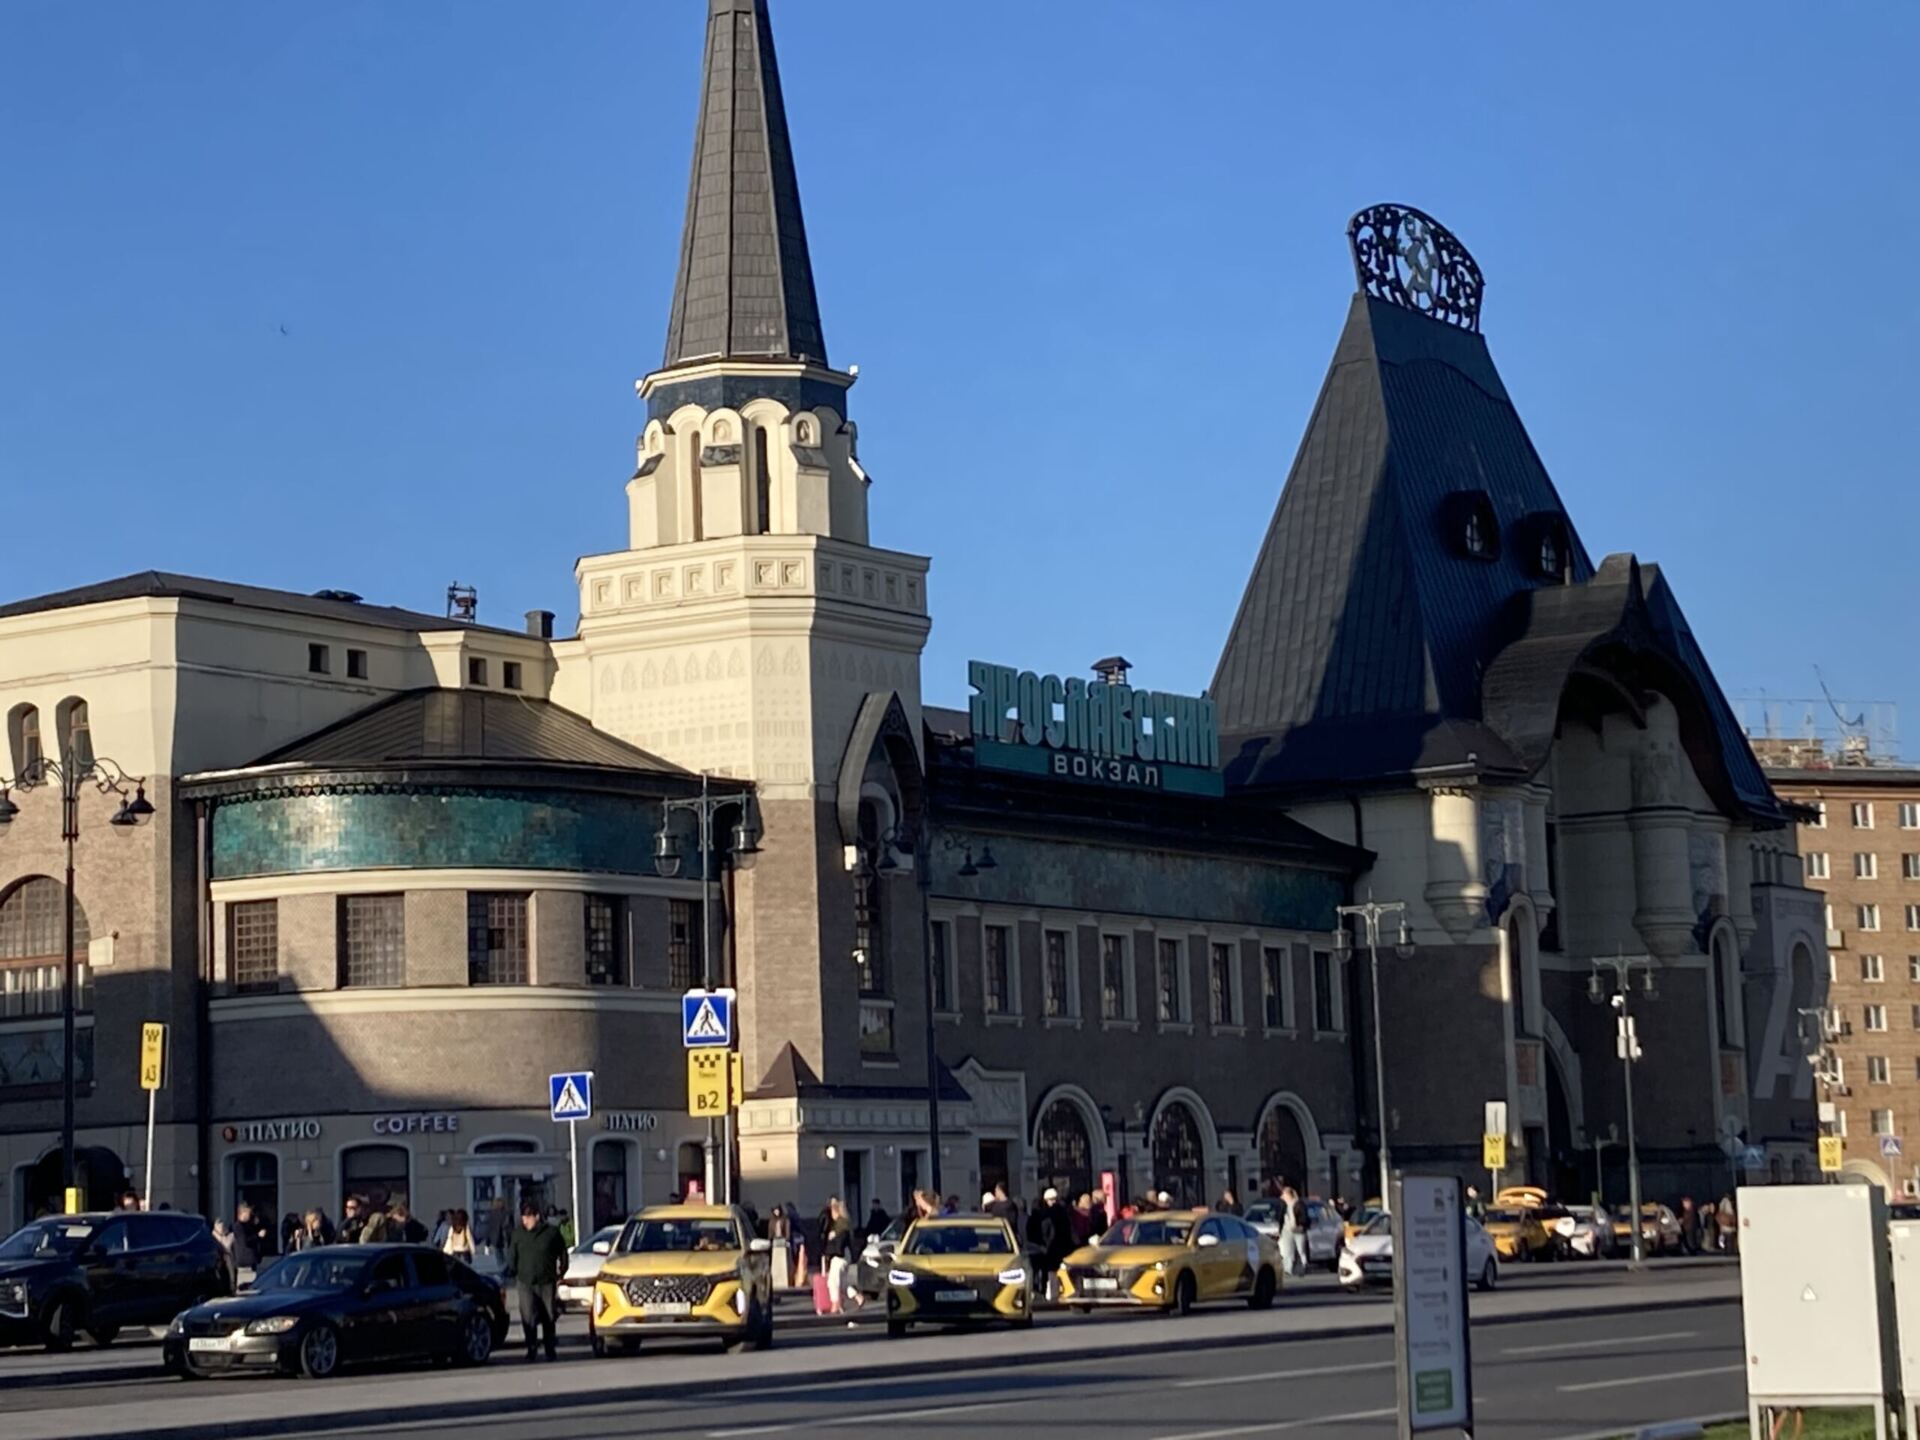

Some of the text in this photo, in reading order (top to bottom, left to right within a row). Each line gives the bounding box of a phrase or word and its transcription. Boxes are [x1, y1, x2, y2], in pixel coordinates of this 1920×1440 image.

[968, 660, 1220, 768] ЯРОСЛАВСКИЙ
[1054, 753, 1159, 786] ВОКЗАЛ
[249, 1120, 320, 1141] ПАТИО
[373, 1115, 457, 1134] COFFEE
[609, 1113, 658, 1131] ПАТИО
